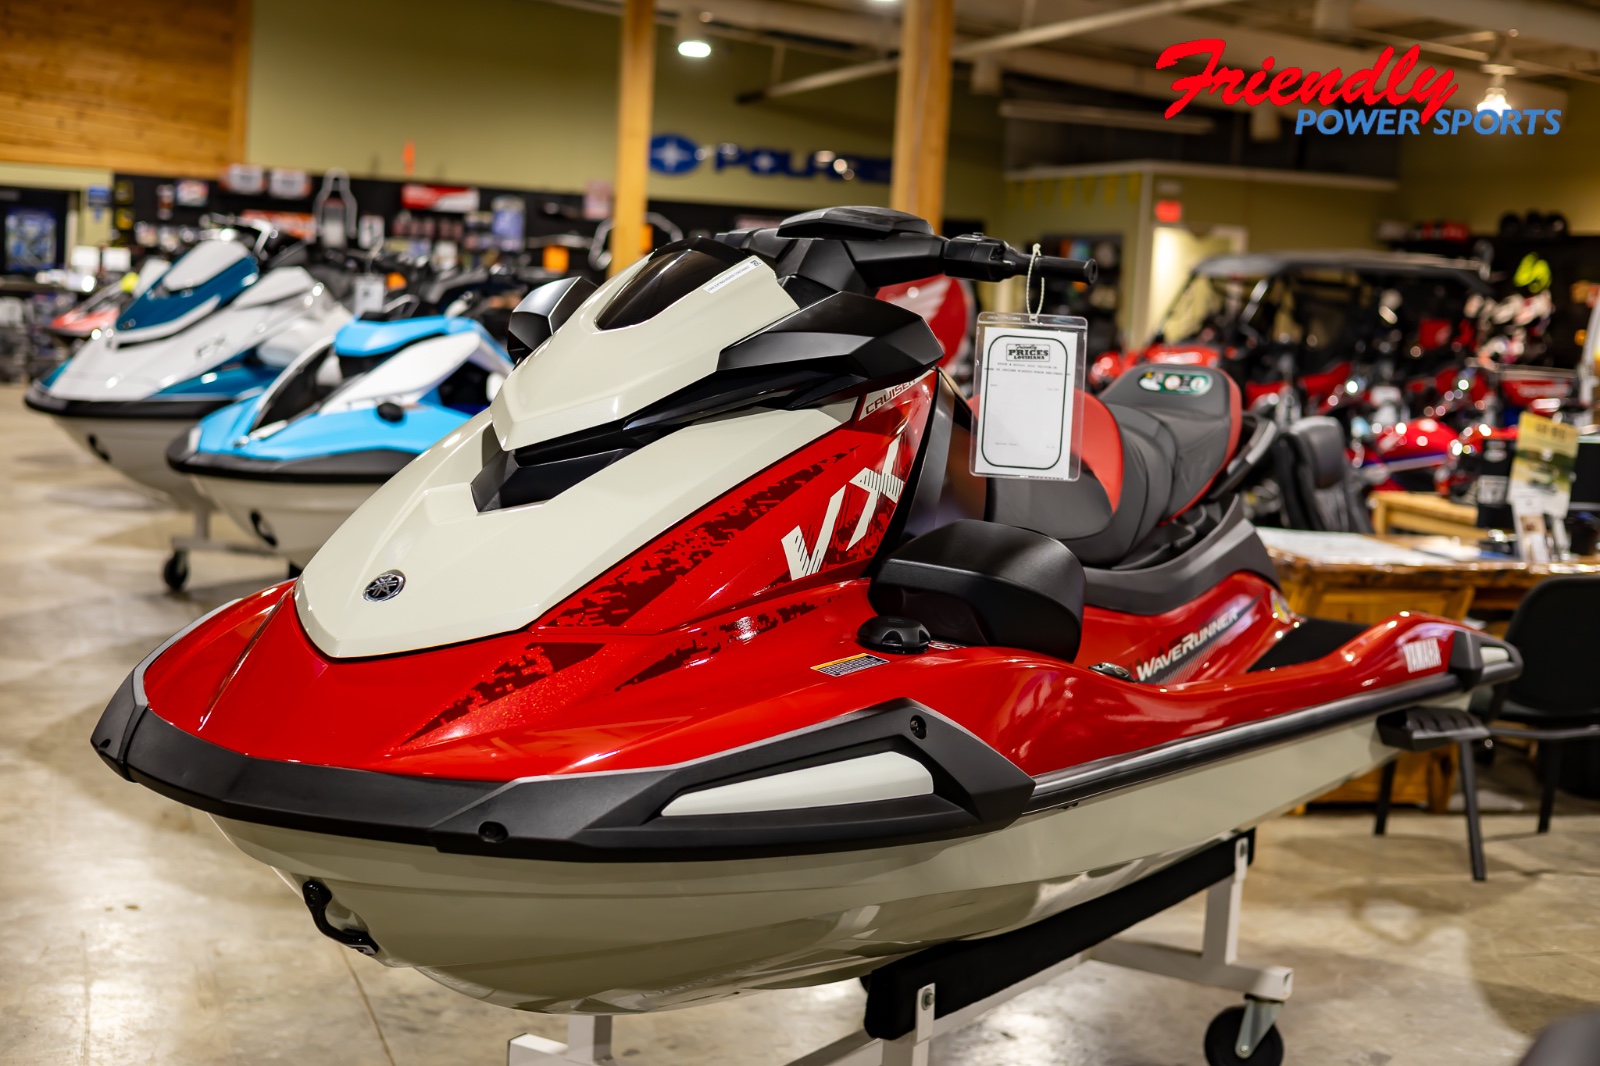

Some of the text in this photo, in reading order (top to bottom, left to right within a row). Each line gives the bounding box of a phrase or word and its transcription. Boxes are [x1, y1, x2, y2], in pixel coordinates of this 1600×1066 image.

[1008, 349, 1049, 357] PRICES
[781, 434, 905, 581] VX
[1402, 637, 1442, 674] YAMAHA
